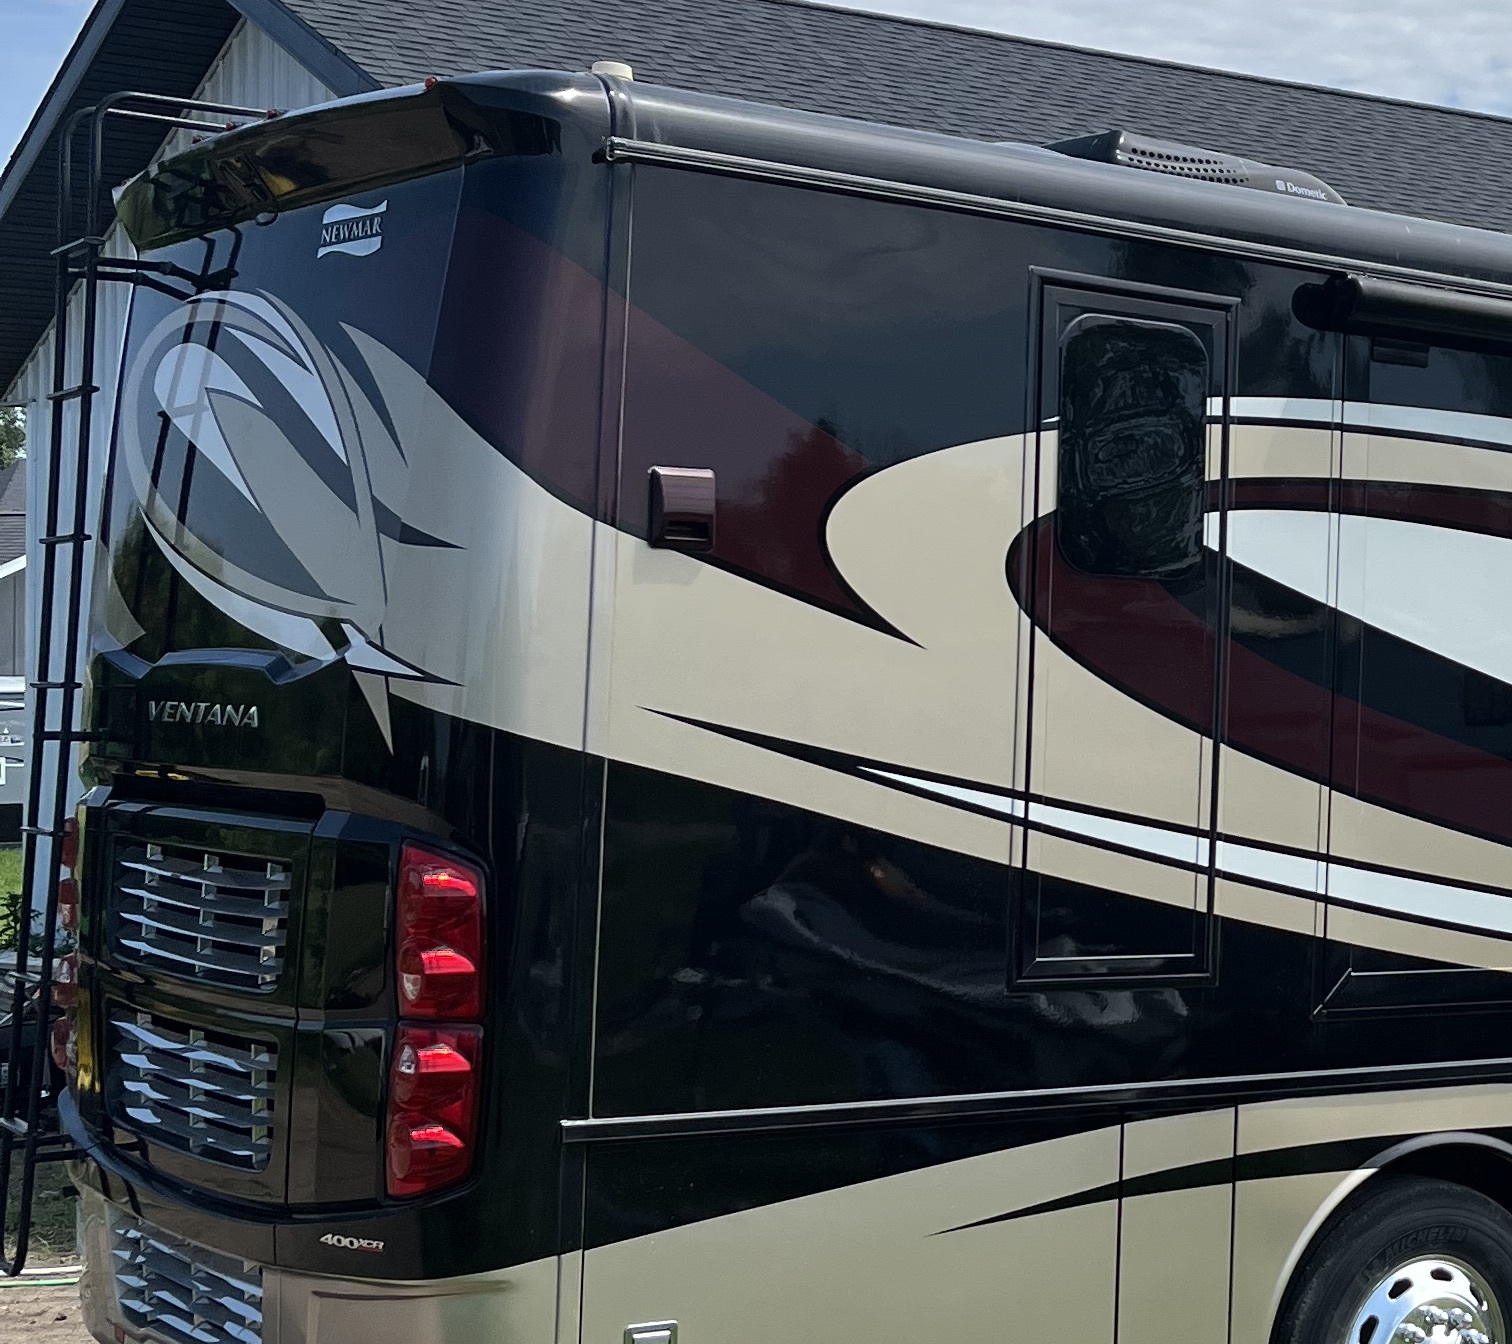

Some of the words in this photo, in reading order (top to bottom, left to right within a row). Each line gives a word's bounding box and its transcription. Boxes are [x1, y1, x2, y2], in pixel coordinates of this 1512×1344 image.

[1286, 181, 1328, 201] Dometic
[320, 216, 382, 245] NEWMAR
[148, 700, 259, 729] VENTANA
